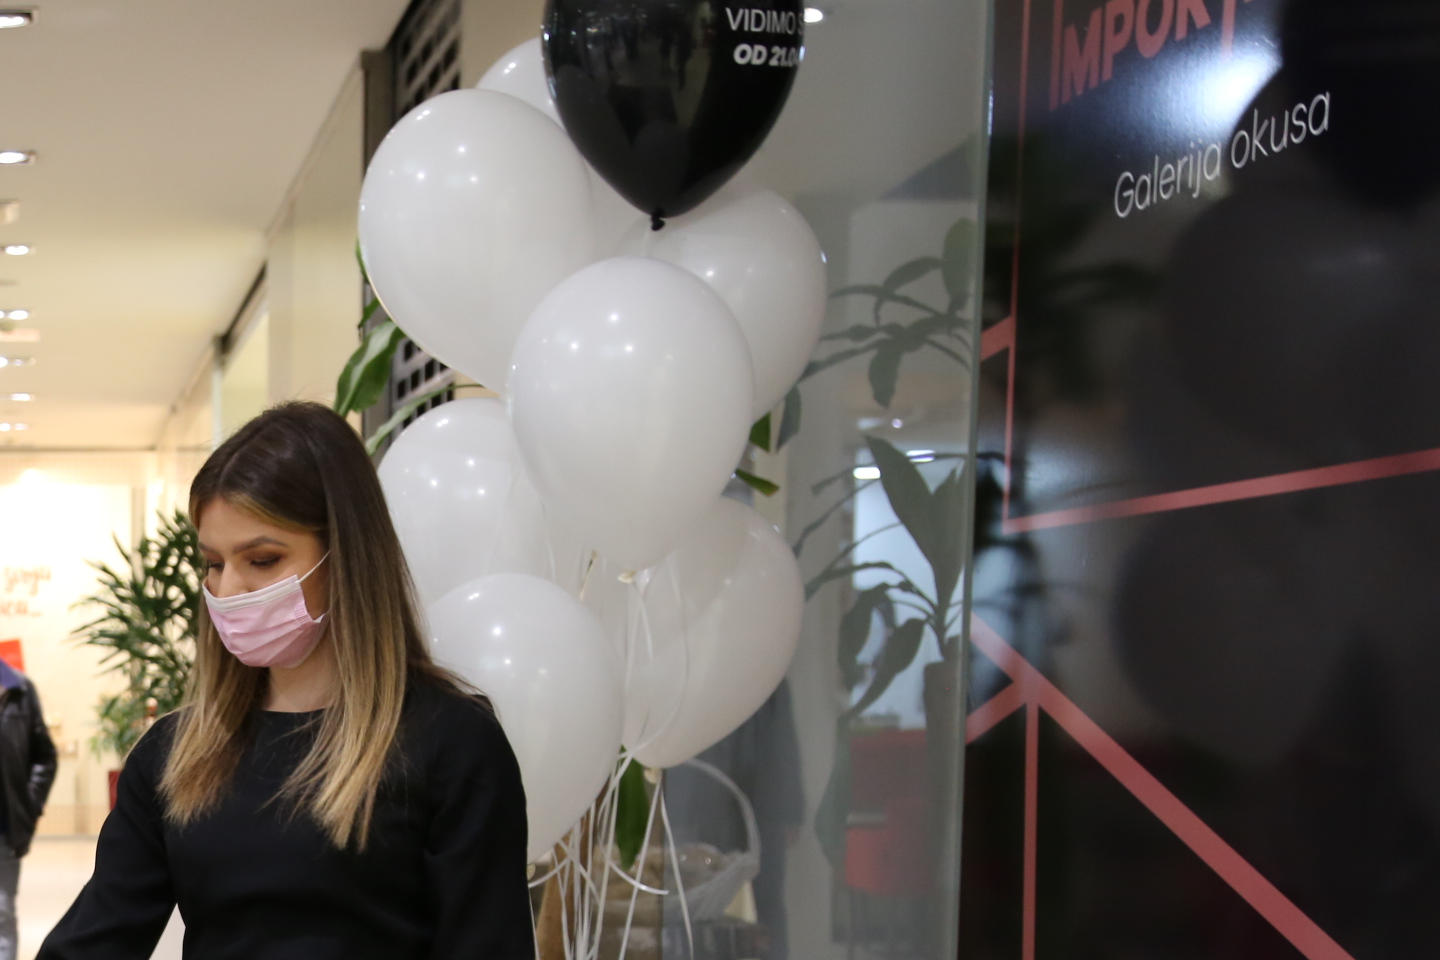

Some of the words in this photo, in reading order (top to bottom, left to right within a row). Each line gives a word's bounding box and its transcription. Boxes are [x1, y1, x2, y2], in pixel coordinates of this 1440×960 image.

[725, 6, 796, 35] VIDIMO
[733, 43, 767, 65] OD
[1113, 139, 1223, 218] Galerija
[1231, 90, 1330, 169] okusa
